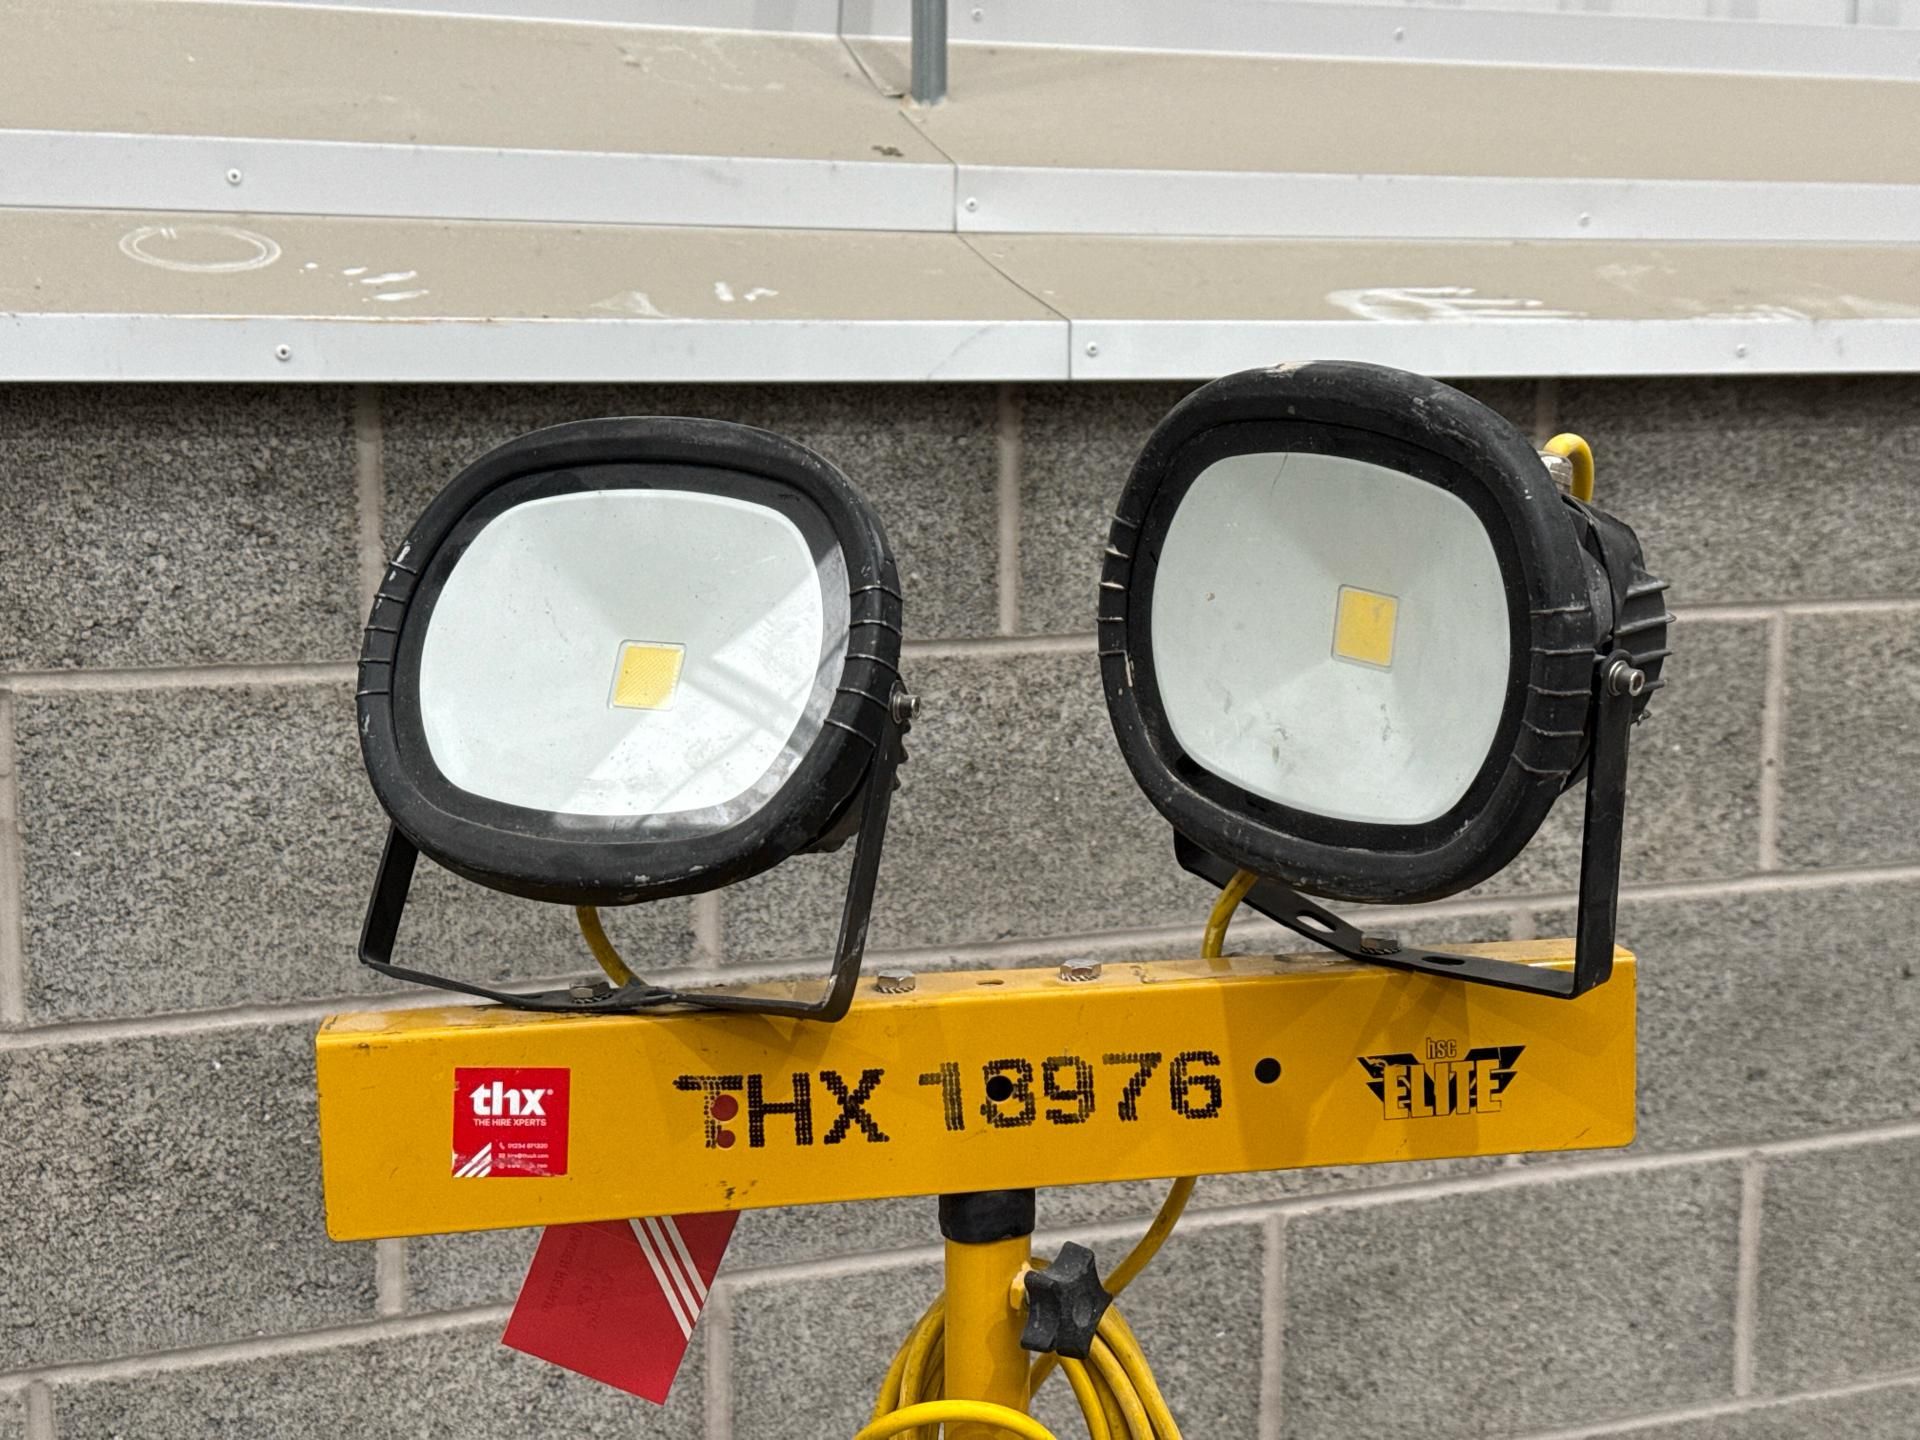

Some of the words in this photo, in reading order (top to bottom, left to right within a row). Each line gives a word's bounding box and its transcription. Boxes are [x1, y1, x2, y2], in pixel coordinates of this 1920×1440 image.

[1426, 1037, 1457, 1060] hsc
[469, 1081, 547, 1116] thx
[672, 1068, 890, 1149] THX
[919, 1050, 1222, 1132] 18976
[1384, 1058, 1502, 1121] ELITE
[473, 1118, 491, 1127] THE
[491, 1118, 512, 1127] HIRE
[513, 1118, 547, 1127] XPERTS
